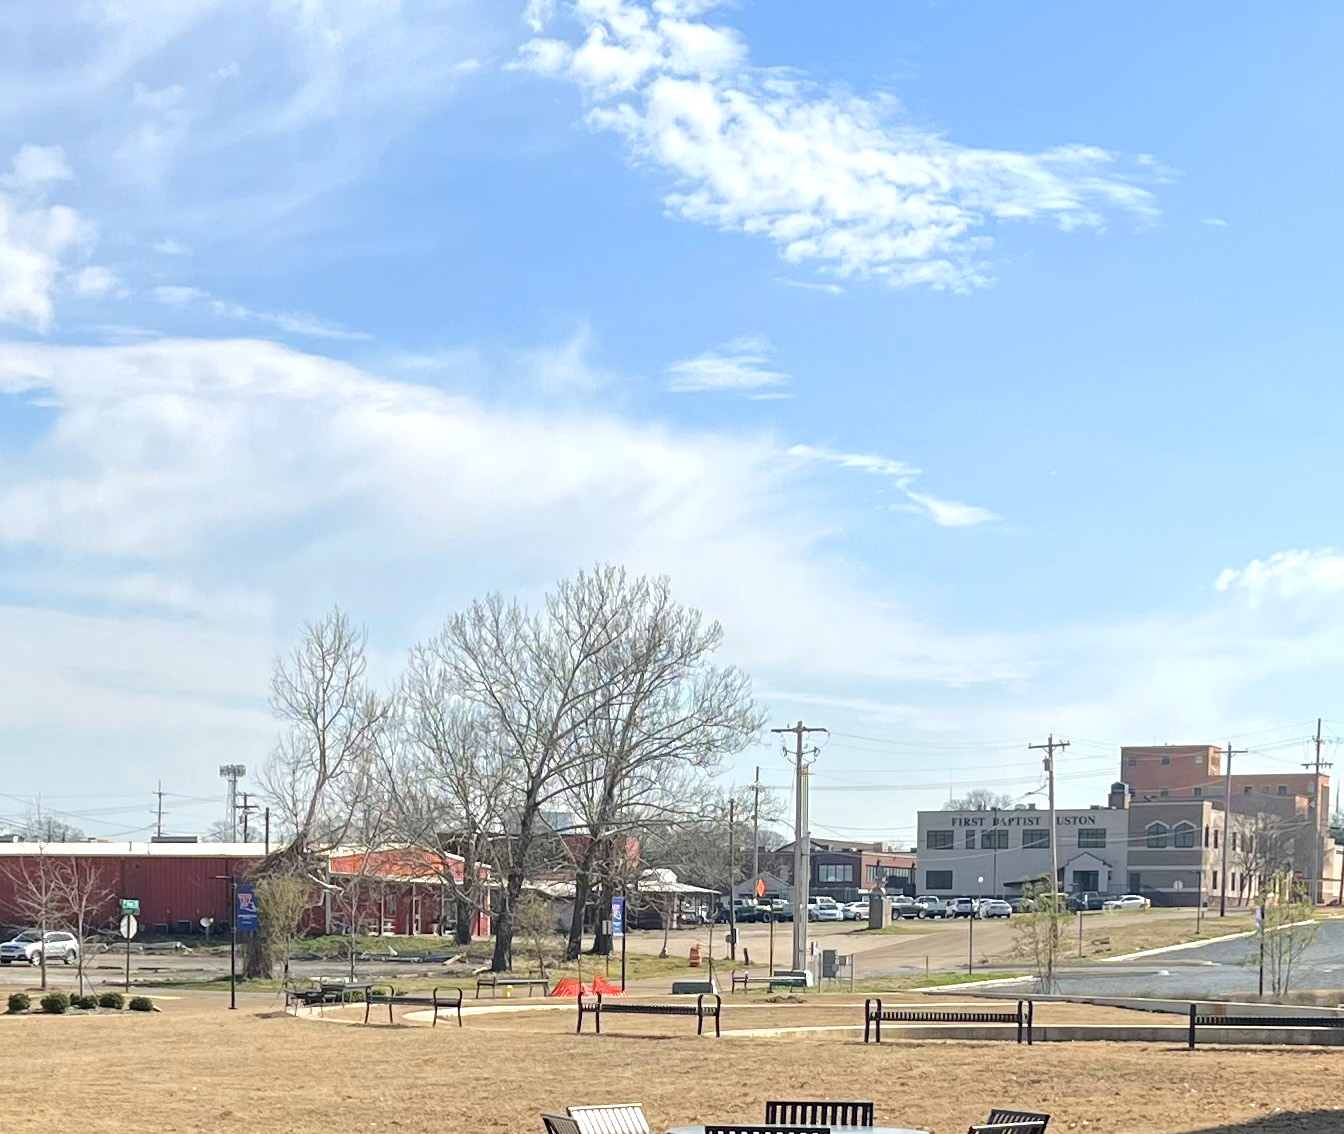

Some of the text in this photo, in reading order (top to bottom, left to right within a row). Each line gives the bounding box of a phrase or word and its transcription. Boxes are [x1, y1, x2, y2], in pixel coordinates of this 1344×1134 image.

[951, 815, 1096, 827] FIRST BAPTIST USTON
